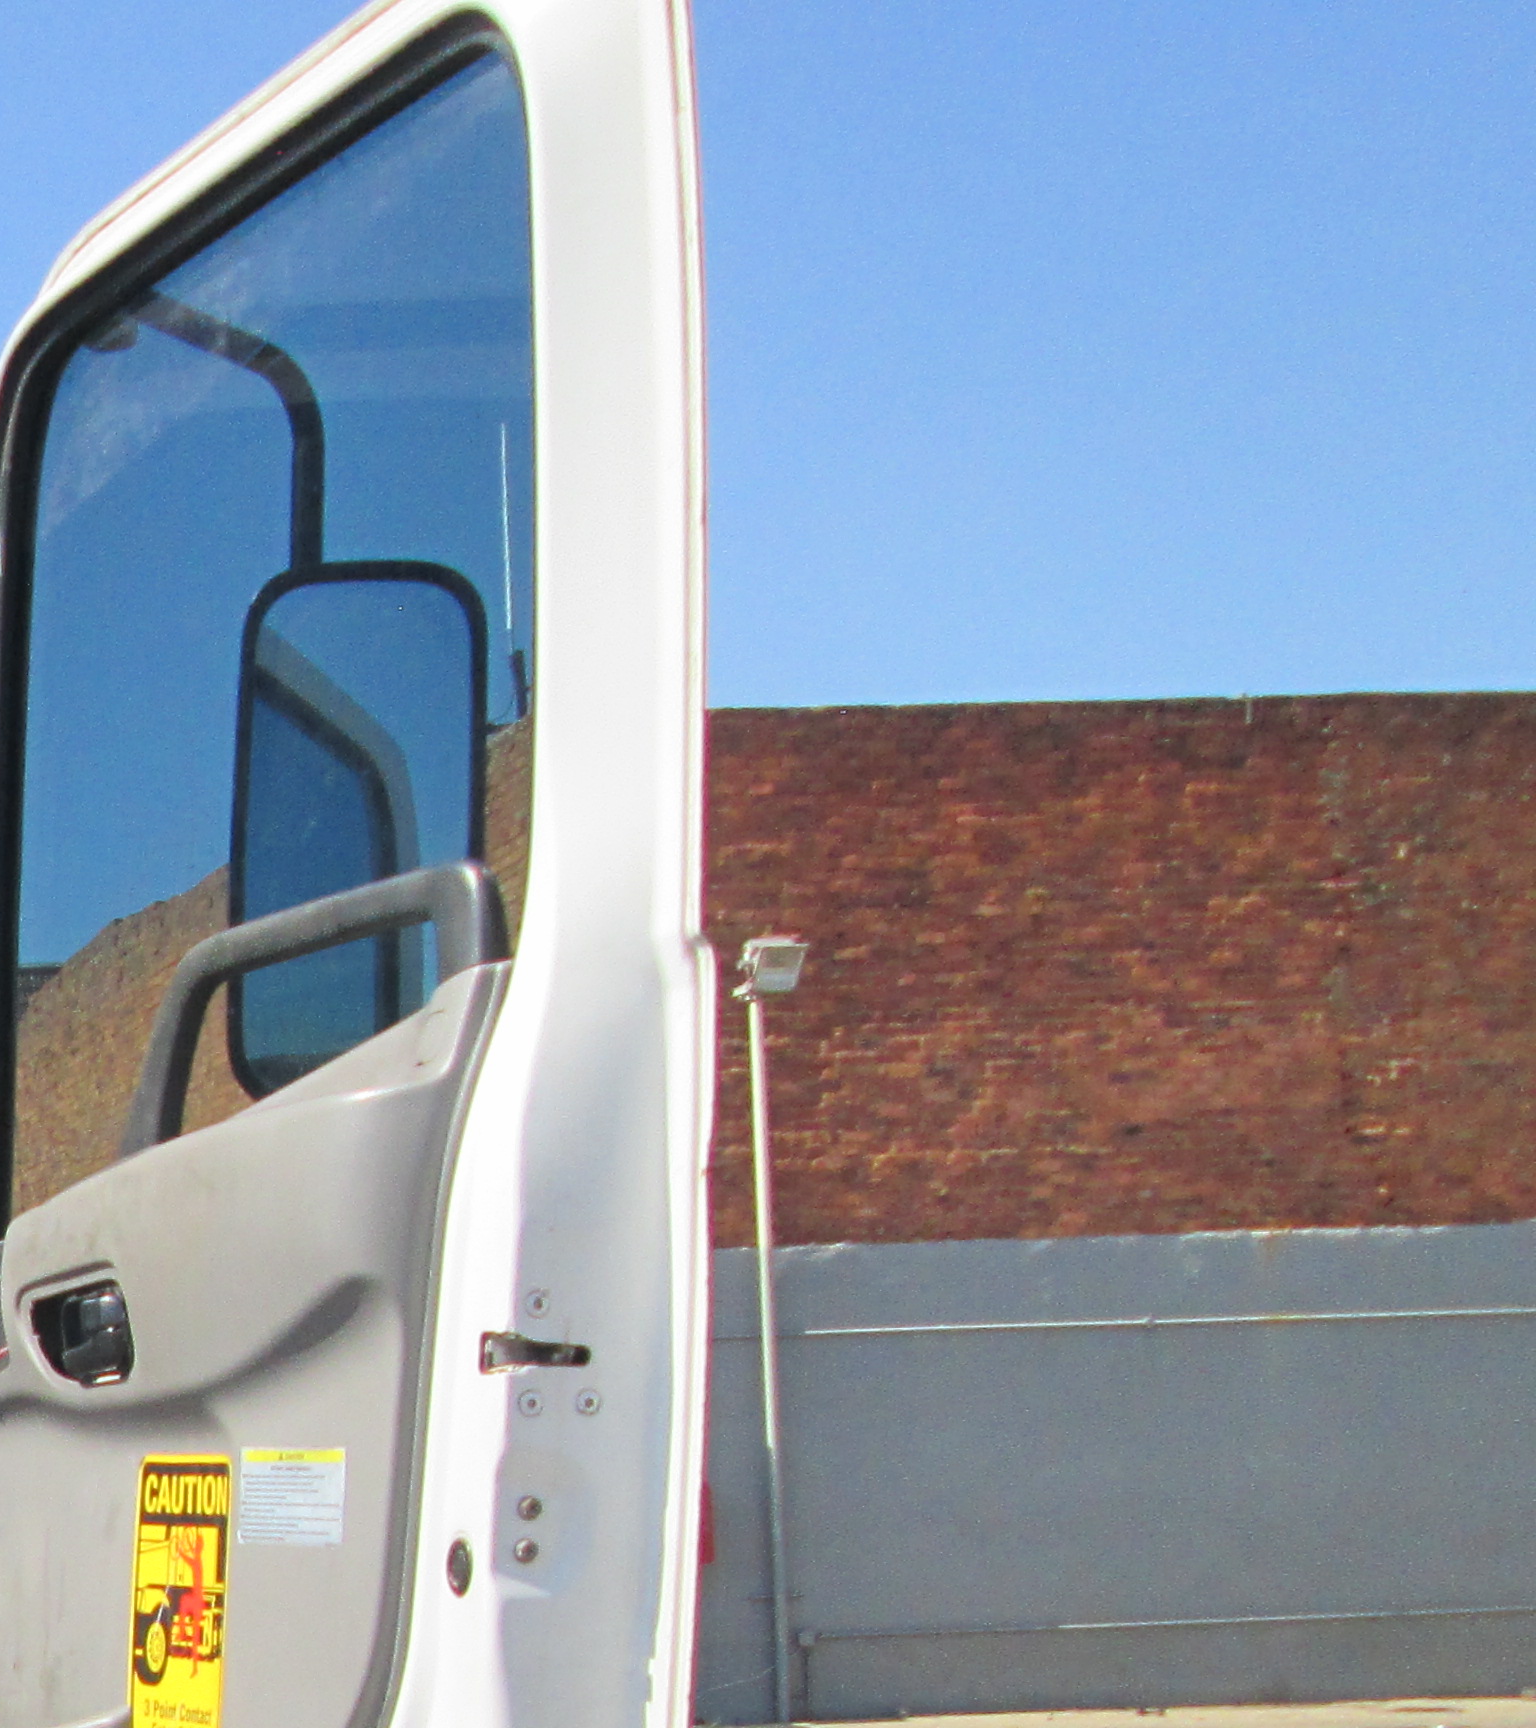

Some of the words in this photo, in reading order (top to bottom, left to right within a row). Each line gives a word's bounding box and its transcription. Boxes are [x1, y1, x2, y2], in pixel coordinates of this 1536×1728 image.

[144, 1473, 228, 1516] CAUTION
[144, 1698, 150, 1717] 3
[153, 1699, 177, 1720] Point
[179, 1703, 212, 1726] Contact
